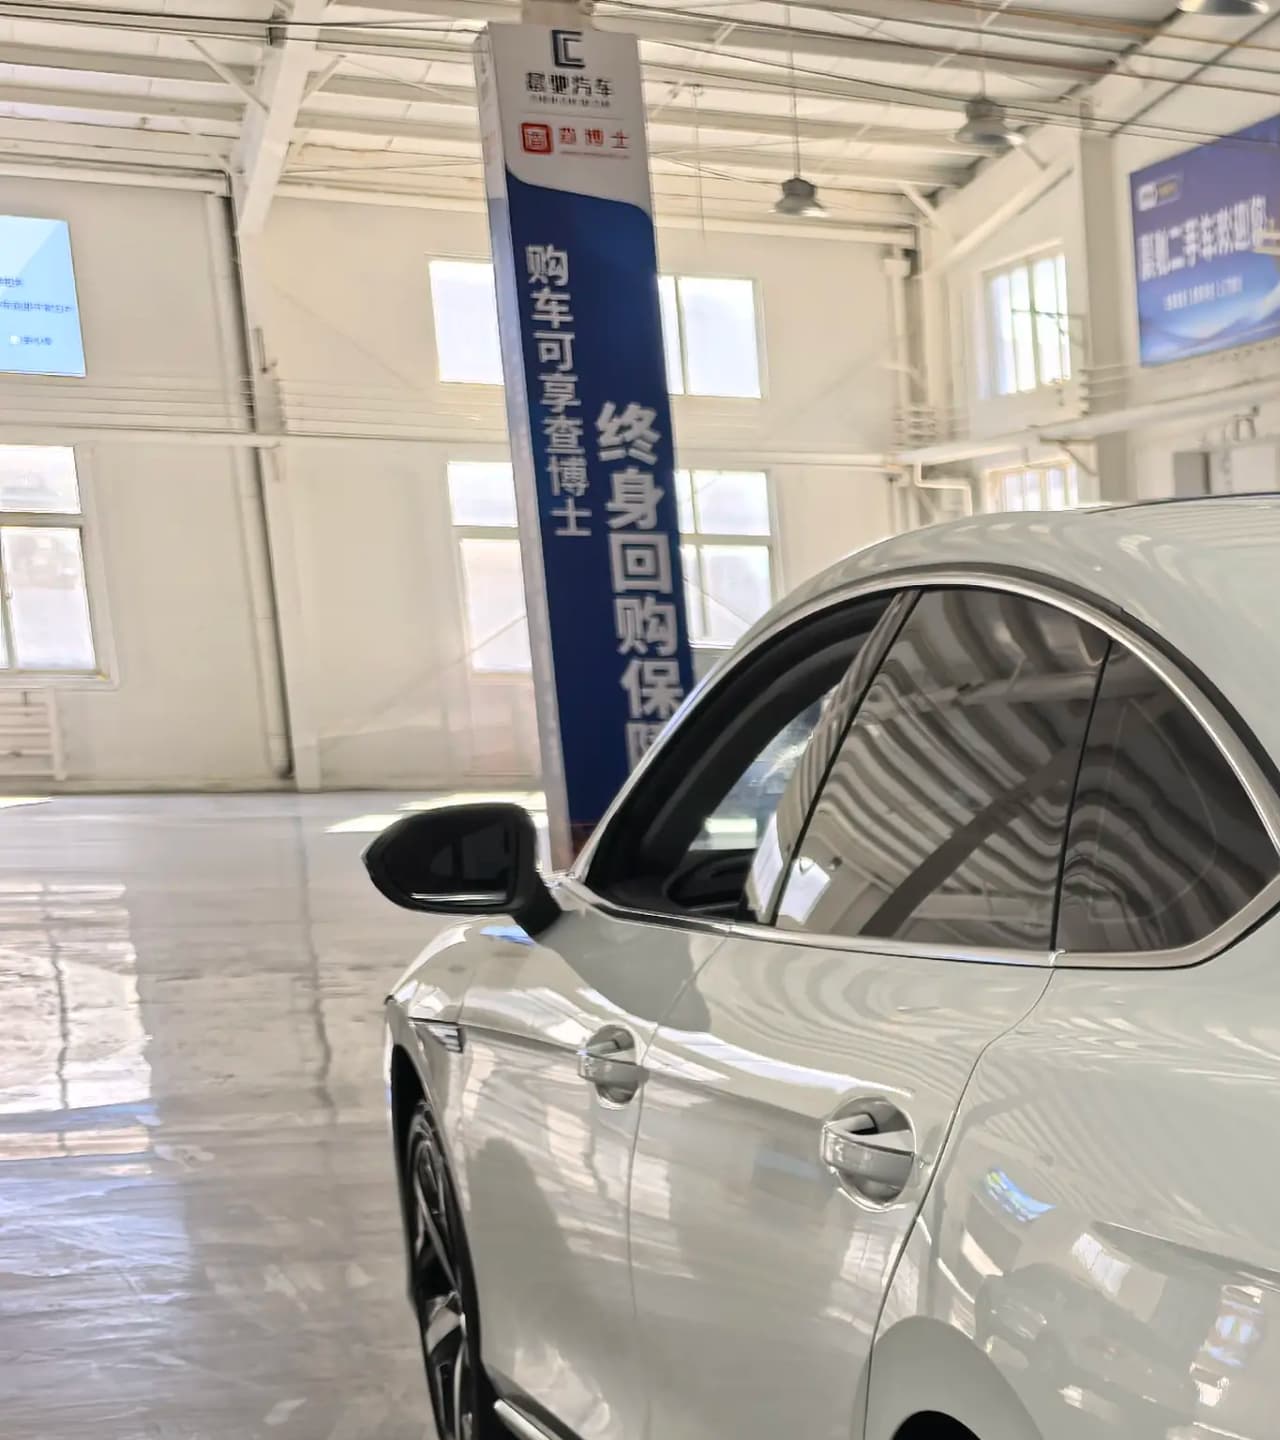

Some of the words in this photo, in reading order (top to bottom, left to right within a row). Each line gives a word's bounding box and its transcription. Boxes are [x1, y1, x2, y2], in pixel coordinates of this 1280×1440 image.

[525, 244, 592, 536] 购车可享查博士
